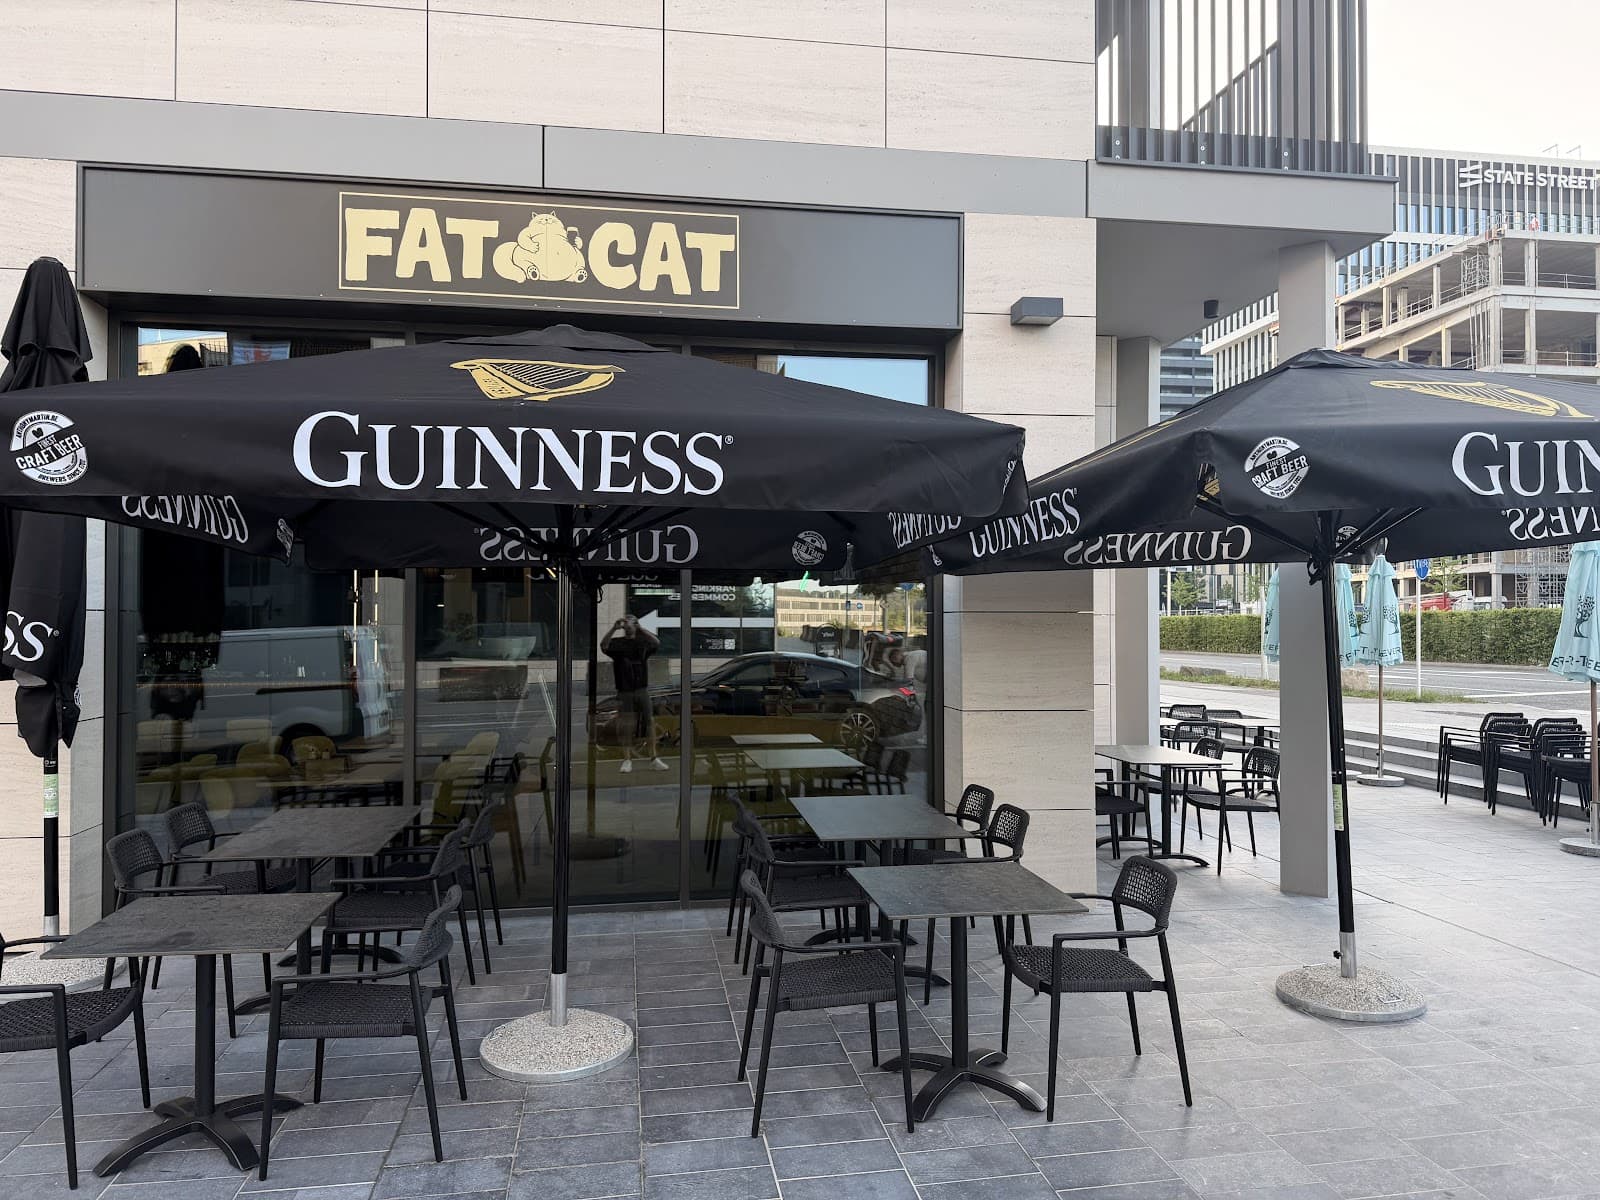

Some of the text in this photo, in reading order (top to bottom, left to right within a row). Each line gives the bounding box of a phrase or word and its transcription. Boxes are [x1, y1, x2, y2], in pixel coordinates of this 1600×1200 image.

[1484, 169, 1600, 190] STATE STREET
[345, 207, 736, 295] FAT CAT
[15, 433, 84, 470] CRAFT BEER
[293, 410, 726, 496] GUINNESS
[1251, 455, 1309, 489] CRAFT BEER
